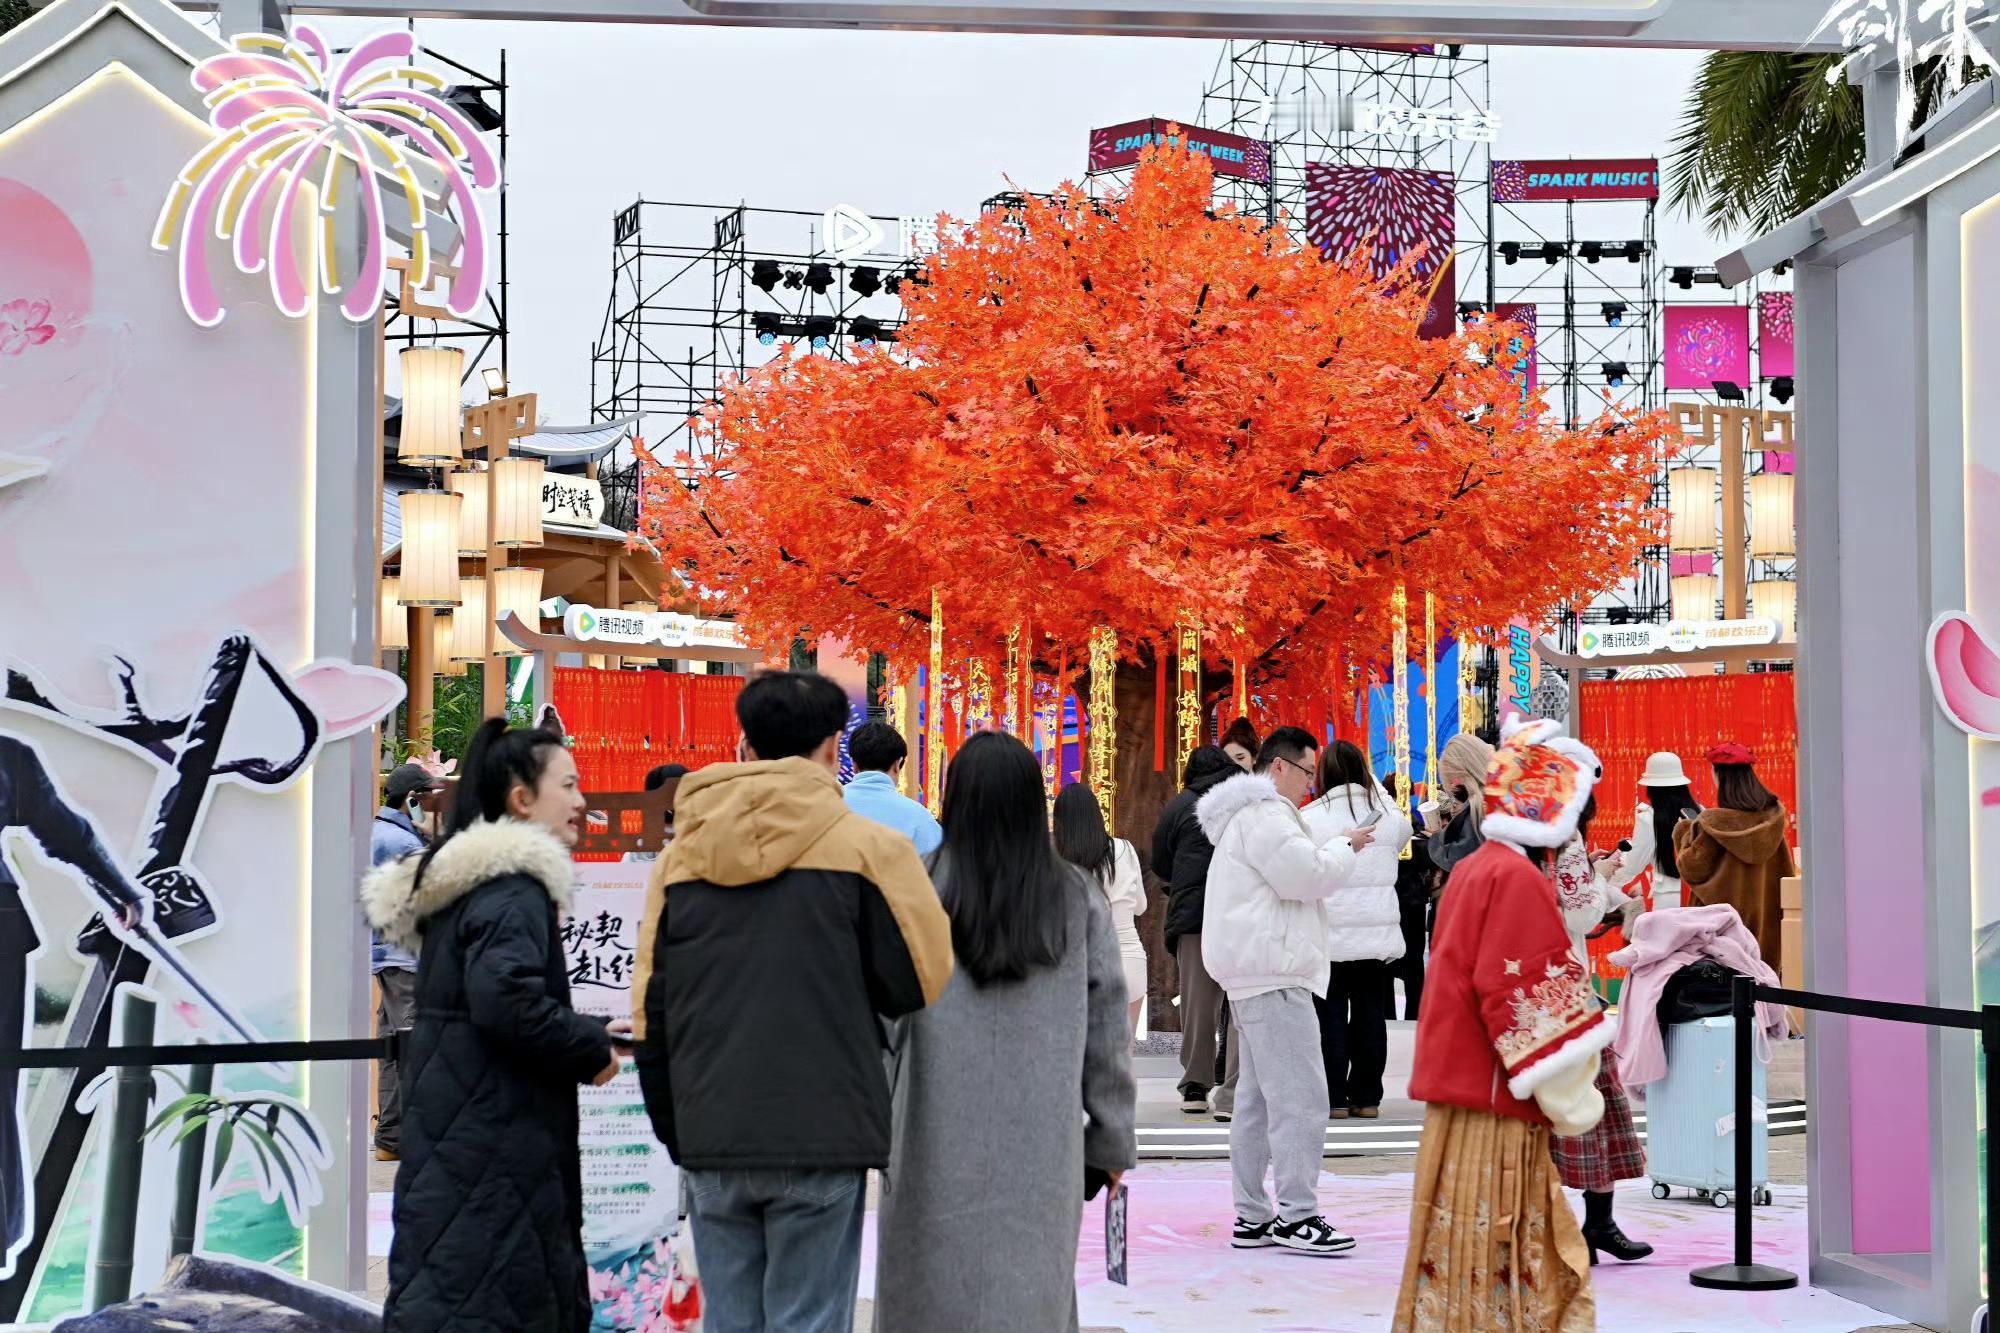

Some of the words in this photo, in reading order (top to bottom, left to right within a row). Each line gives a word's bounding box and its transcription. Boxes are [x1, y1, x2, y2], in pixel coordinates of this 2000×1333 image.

[1210, 144, 1244, 164] WEEK
[1527, 173, 1588, 188] SPARK
[1590, 171, 1649, 187] MUSIC
[598, 616, 644, 636] 腾讯视频
[1602, 631, 1650, 649] 腾讯视频
[1509, 624, 1531, 715] HAPPY
[560, 910, 641, 954] 秘契
